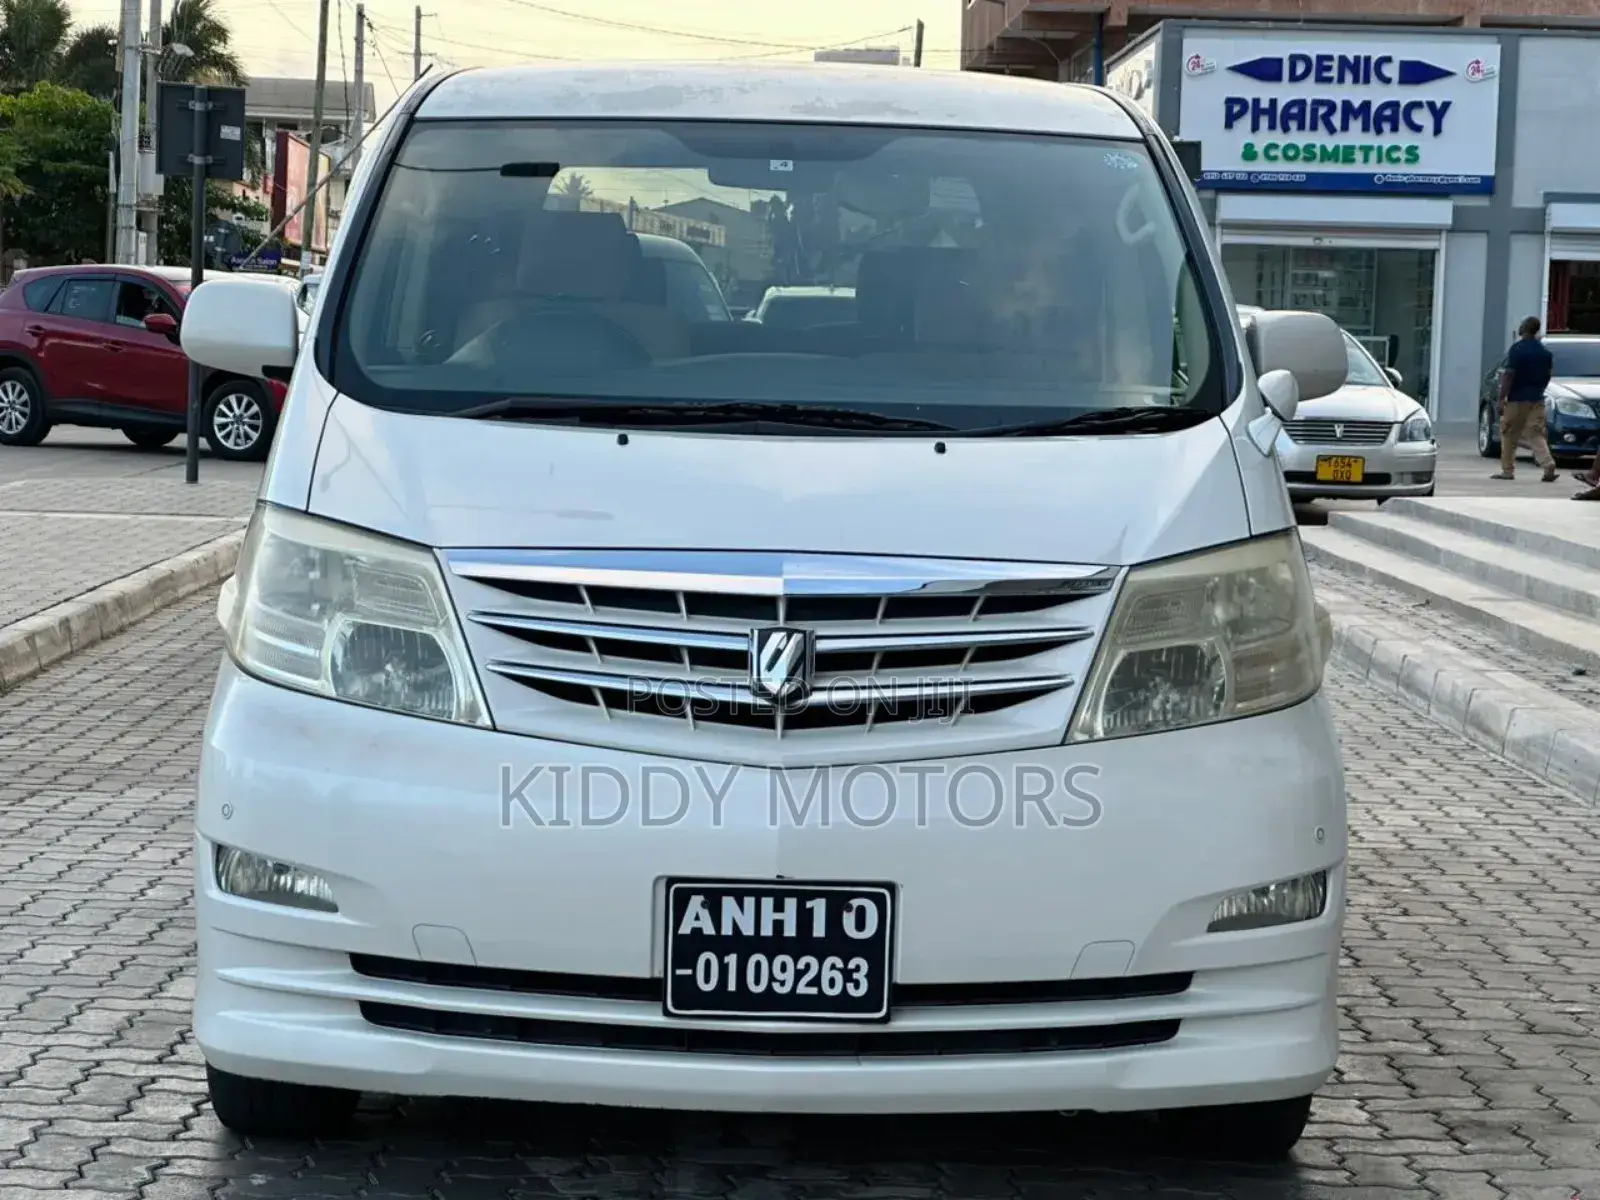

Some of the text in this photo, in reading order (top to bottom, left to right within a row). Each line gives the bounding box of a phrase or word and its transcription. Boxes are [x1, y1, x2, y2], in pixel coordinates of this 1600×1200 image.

[1288, 53, 1393, 85] DENIC
[1224, 96, 1453, 136] PHARMACY
[1241, 142, 1420, 164] & COSMETICS
[675, 951, 869, 998] -0109263
